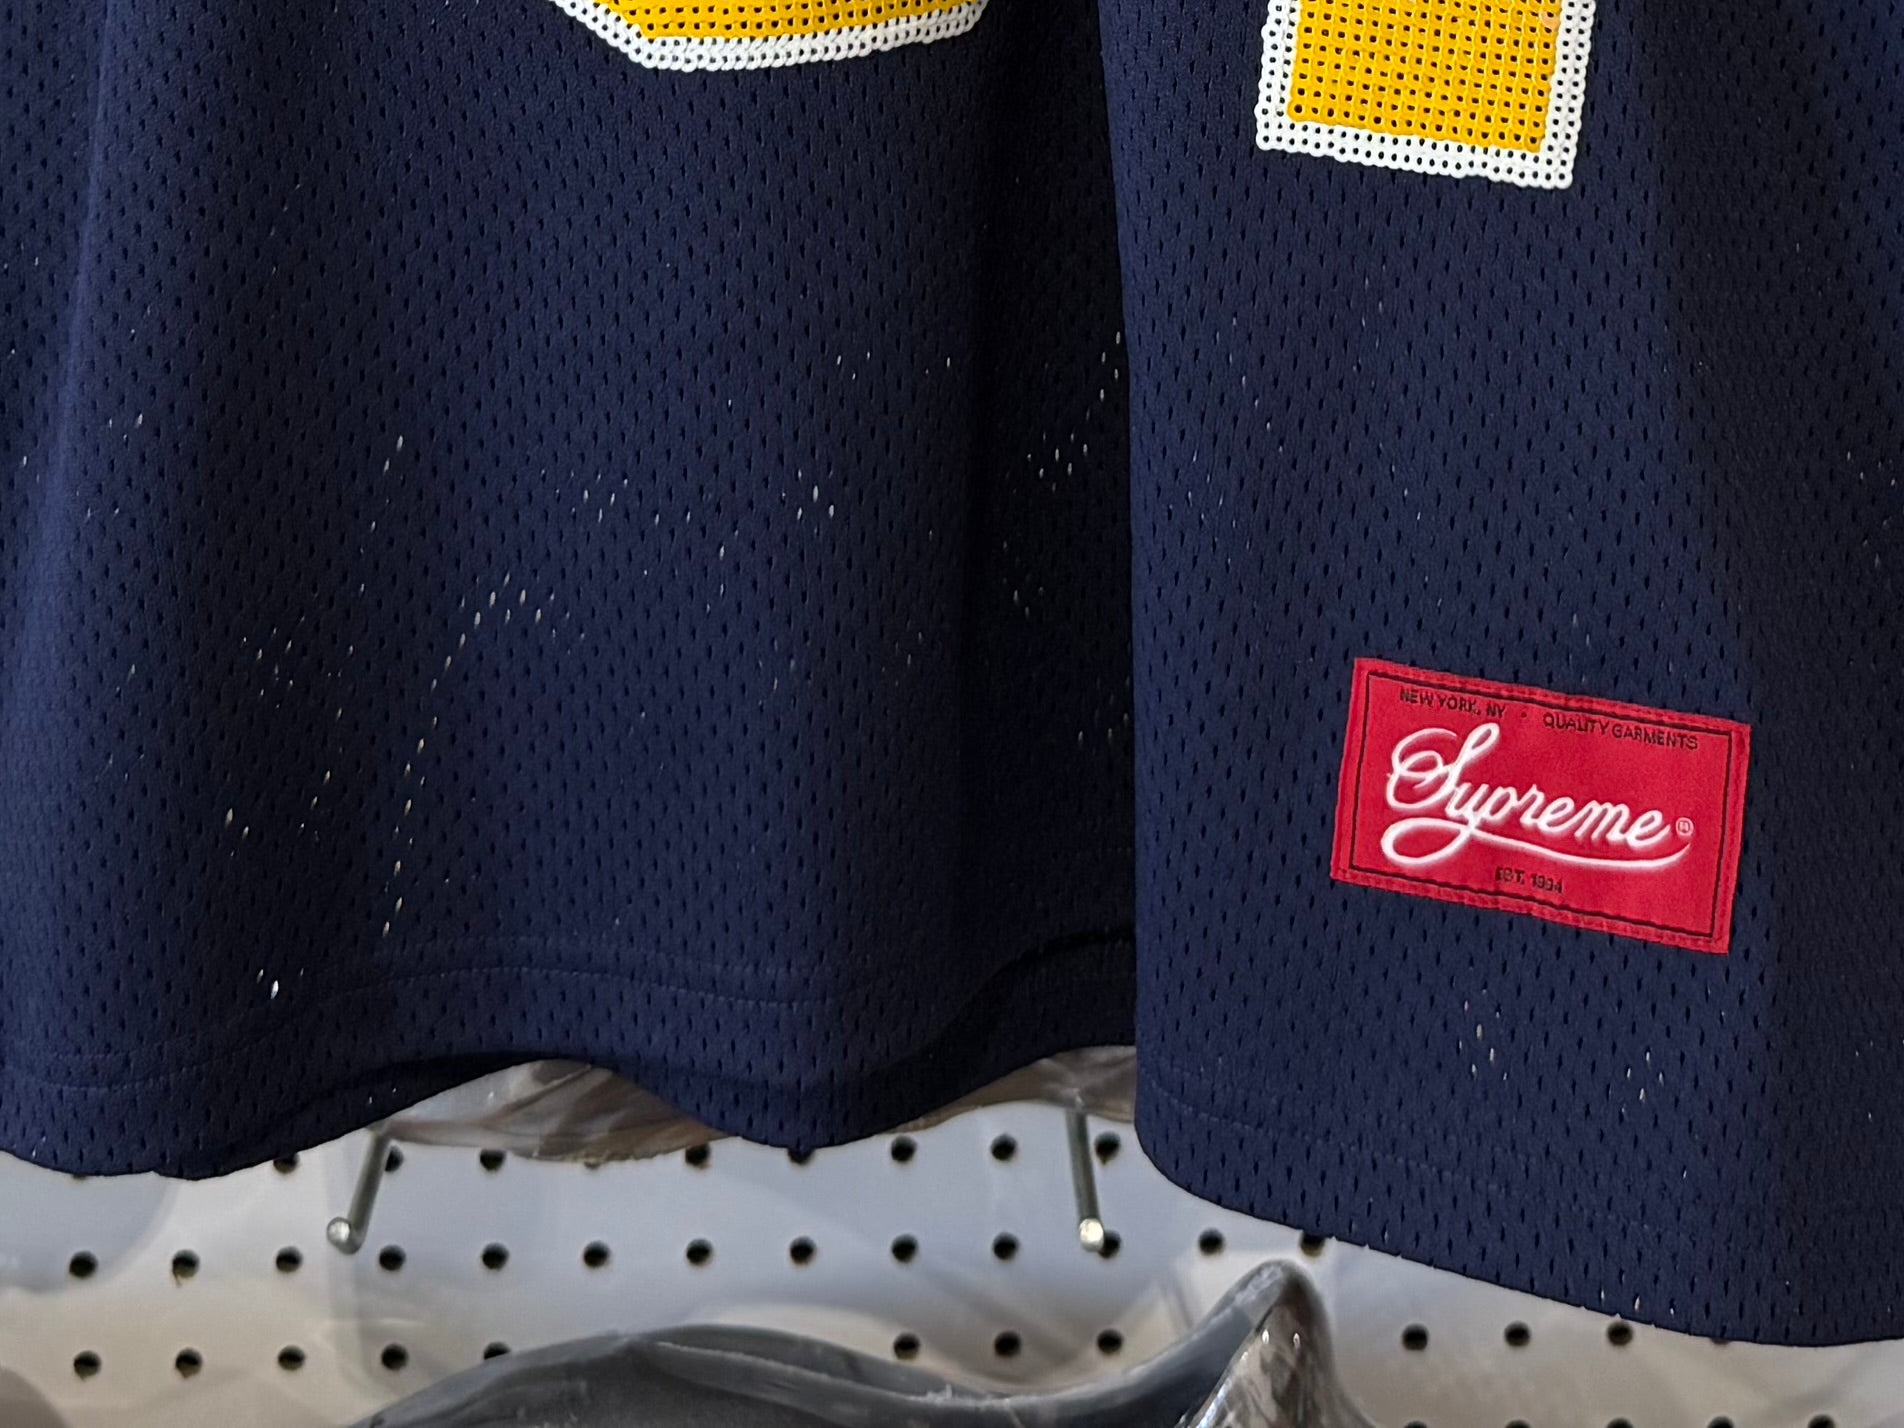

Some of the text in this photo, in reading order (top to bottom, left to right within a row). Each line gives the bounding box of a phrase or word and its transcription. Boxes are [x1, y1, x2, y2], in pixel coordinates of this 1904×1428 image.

[1400, 688, 1506, 719] NEW YORK, NY
[1543, 712, 1699, 751] QUALITY GARMENTS
